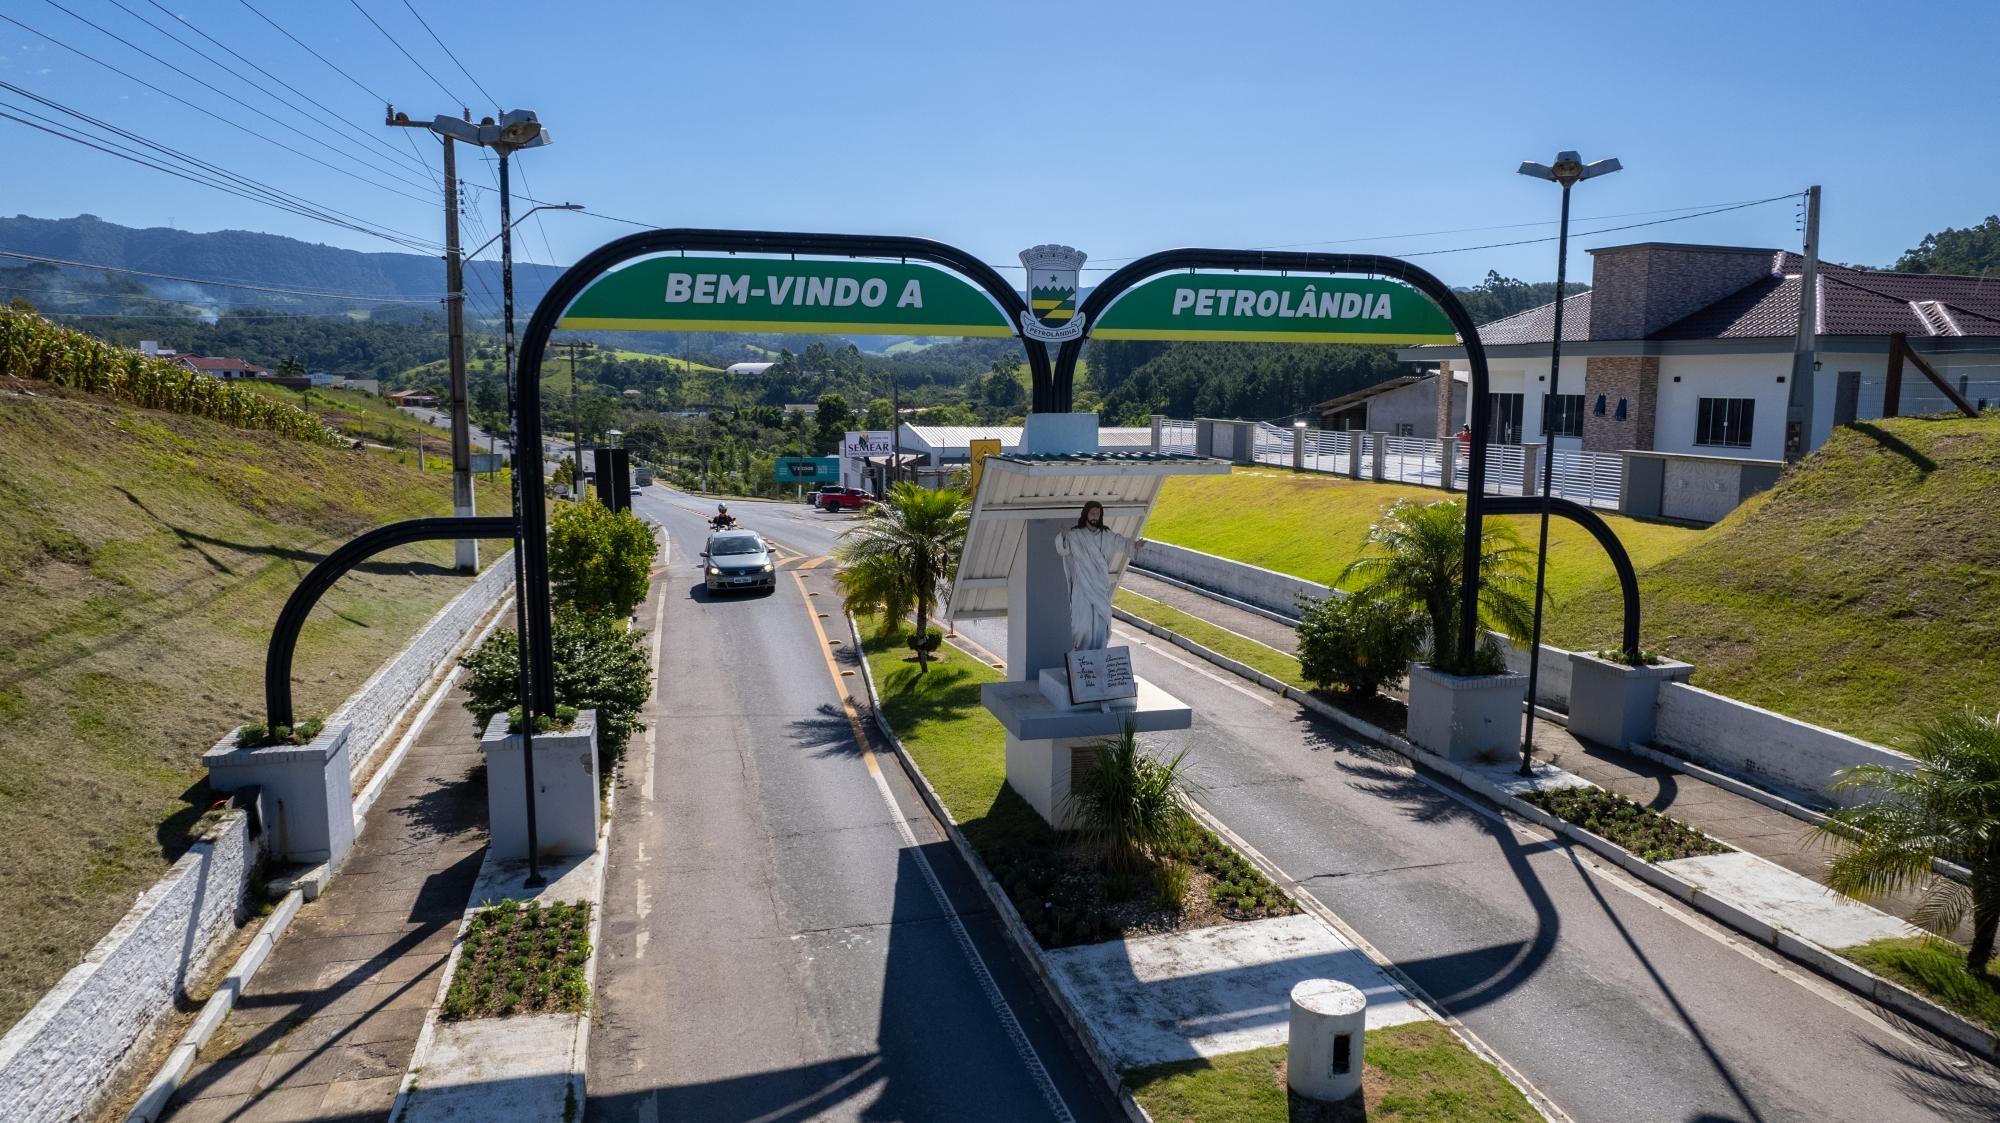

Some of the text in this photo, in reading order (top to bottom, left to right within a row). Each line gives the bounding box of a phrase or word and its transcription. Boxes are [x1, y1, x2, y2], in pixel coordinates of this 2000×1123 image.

[665, 273, 923, 309] BEM-VINDO A
[1172, 284, 1393, 320] PETROLÂNDIA
[848, 443, 889, 452] SEMEAR
